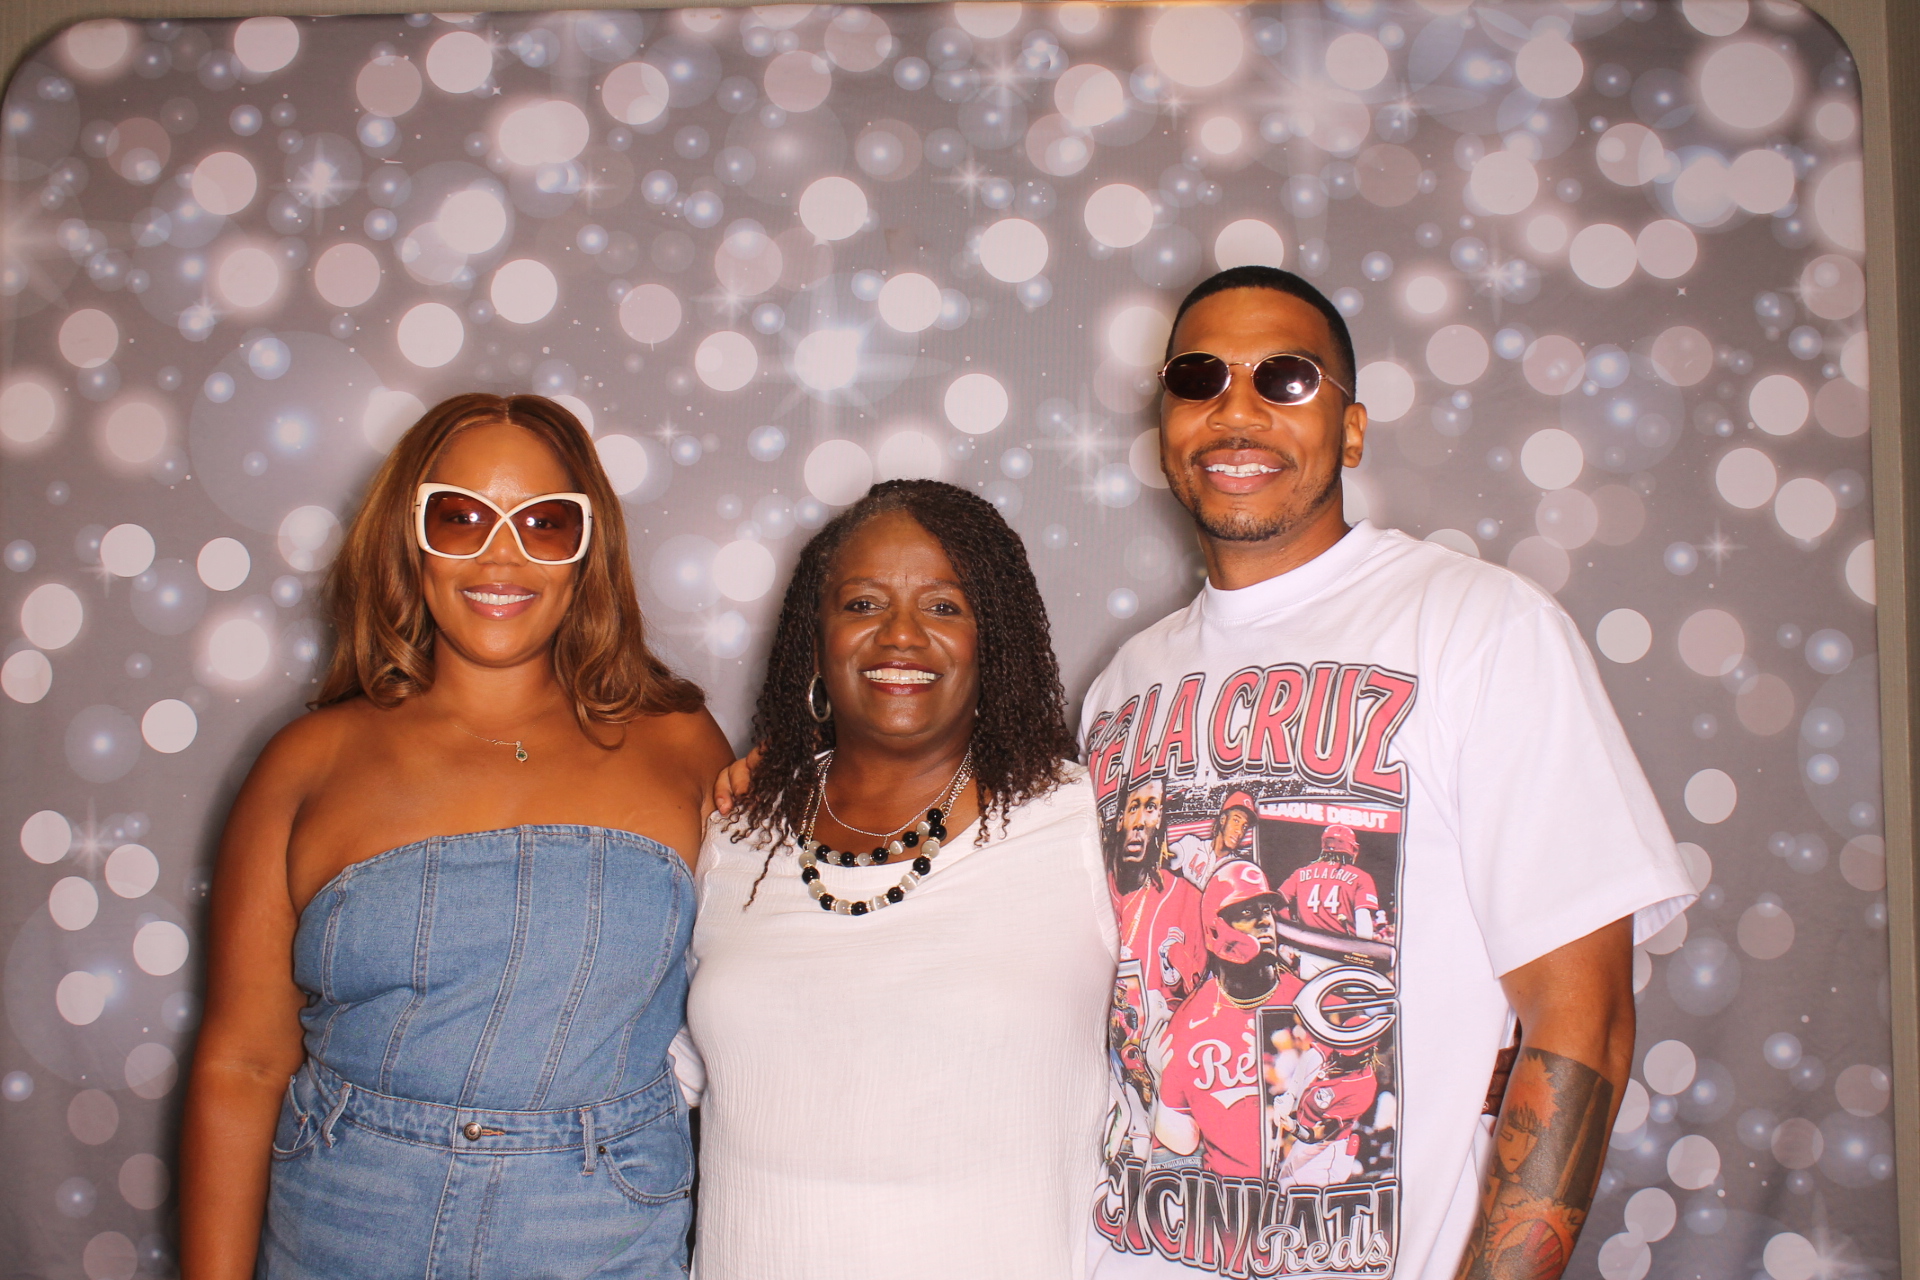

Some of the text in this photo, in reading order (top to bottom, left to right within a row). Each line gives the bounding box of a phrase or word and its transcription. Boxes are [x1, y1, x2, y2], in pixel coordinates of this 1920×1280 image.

[1128, 672, 1206, 792] LA
[1208, 661, 1418, 808] CRUZ
[1327, 806, 1388, 829] DEBUT
[1189, 854, 1206, 880] 44
[1300, 867, 1358, 885] DE LA CRUZ
[1306, 884, 1340, 914] 44
[1250, 1214, 1392, 1277] Reds
